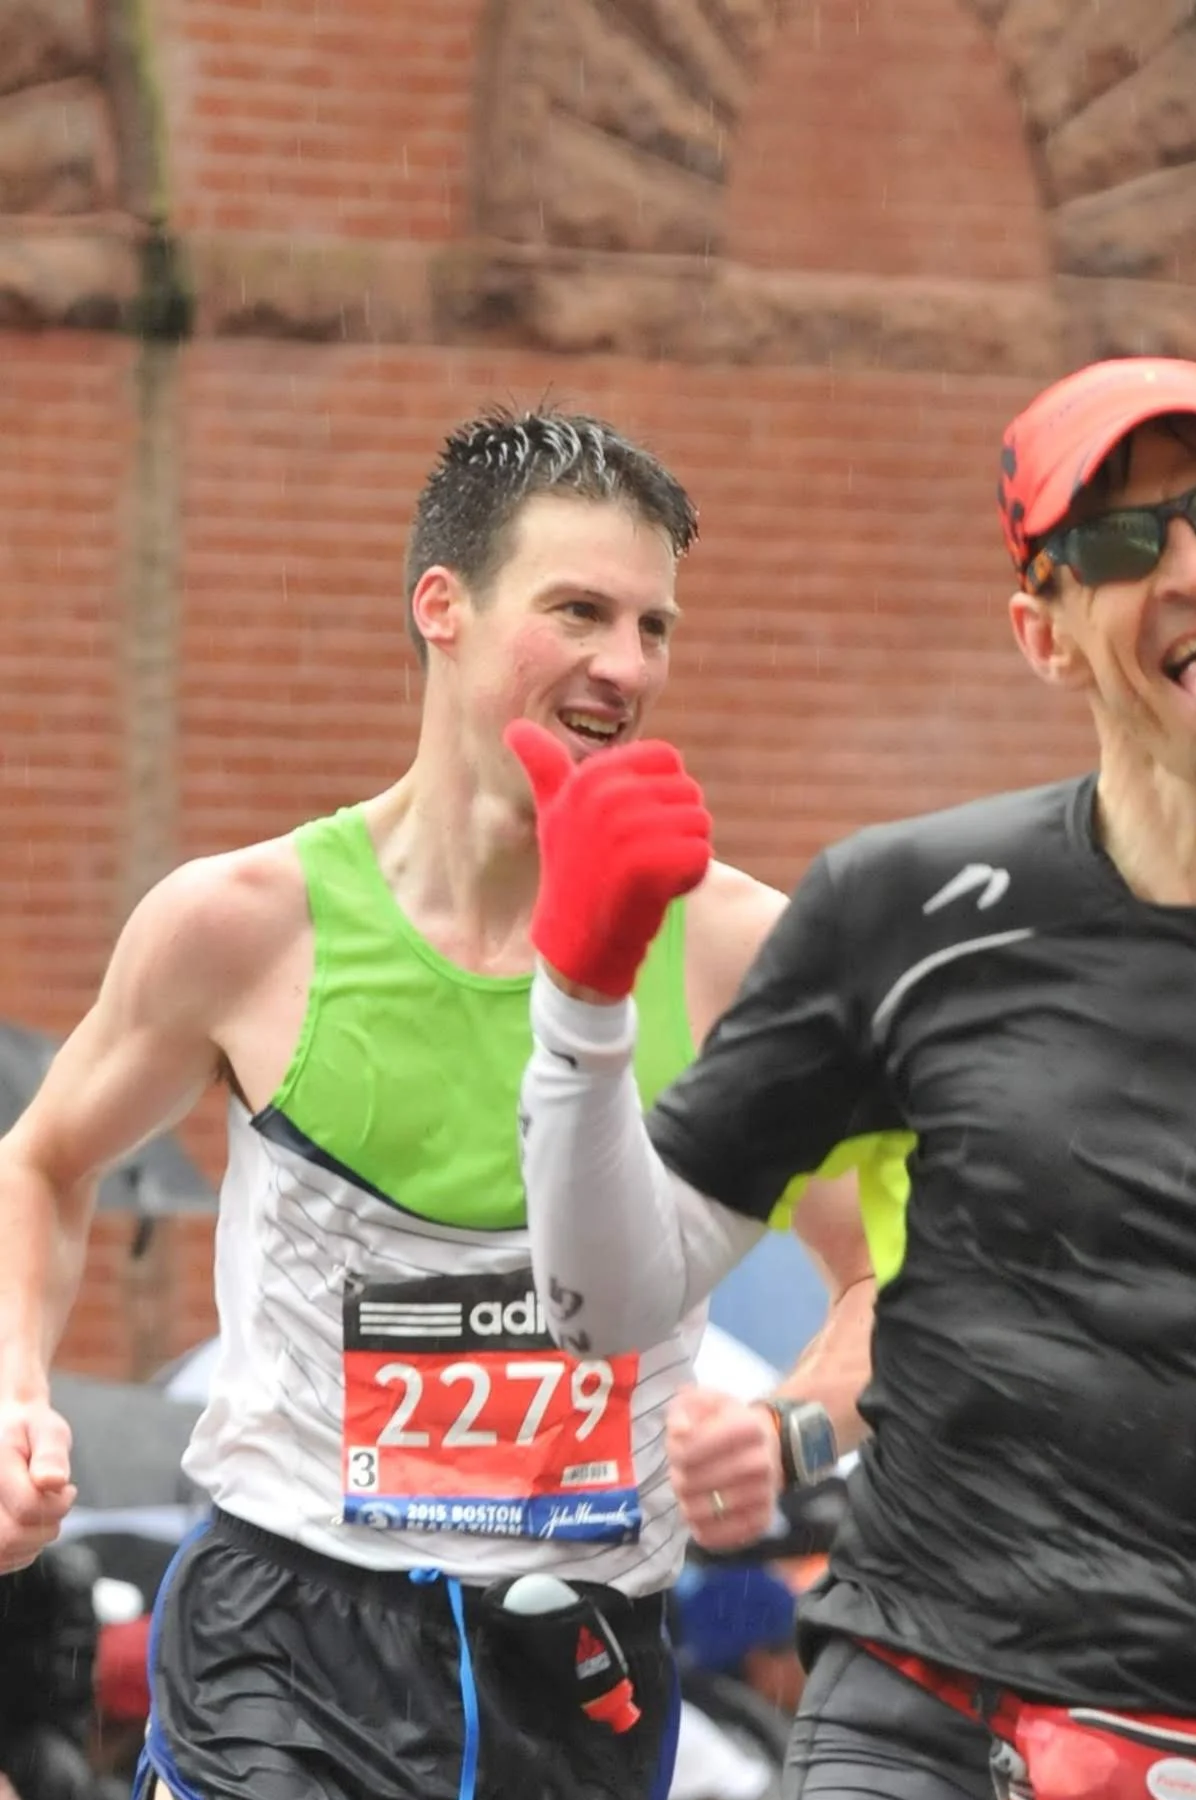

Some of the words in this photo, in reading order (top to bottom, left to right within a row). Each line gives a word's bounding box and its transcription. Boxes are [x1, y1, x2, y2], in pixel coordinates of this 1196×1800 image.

[469, 1290, 546, 1336] adi
[374, 1361, 614, 1448] 2279
[351, 1452, 376, 1487] 3
[407, 1503, 447, 1522] 2015
[451, 1504, 522, 1524] BOSTON
